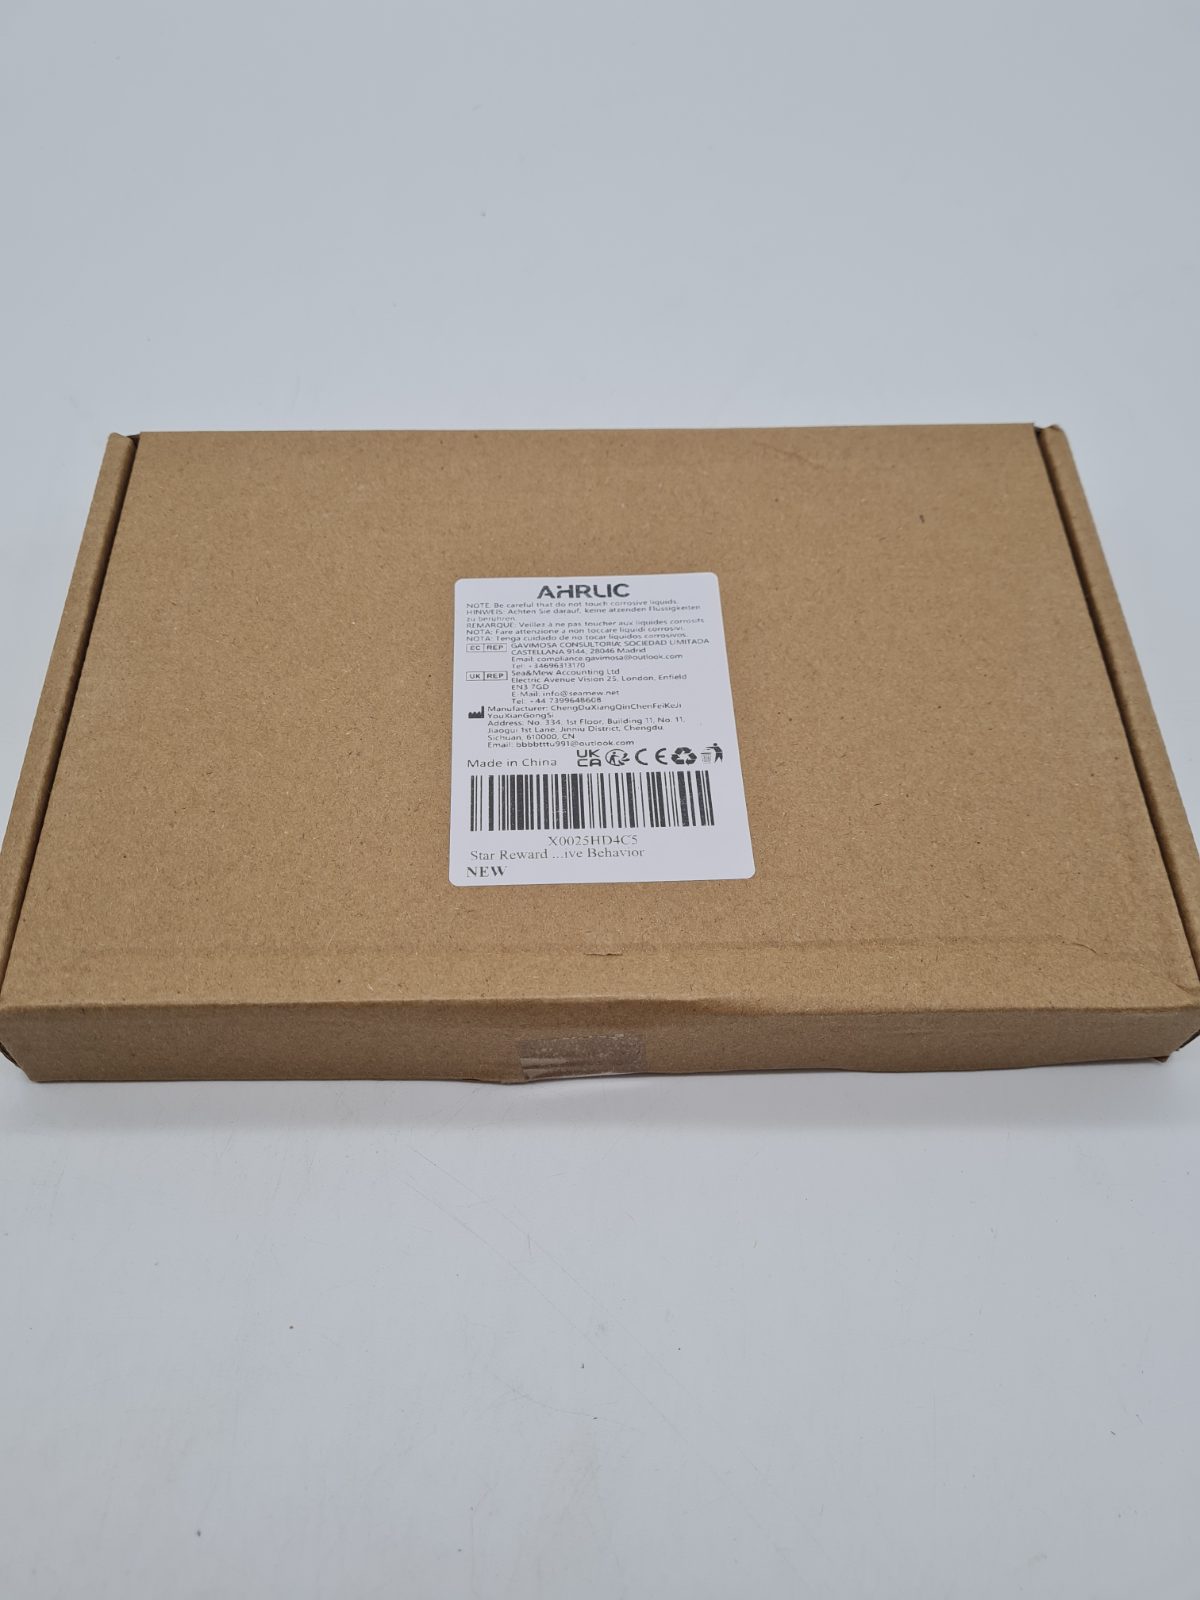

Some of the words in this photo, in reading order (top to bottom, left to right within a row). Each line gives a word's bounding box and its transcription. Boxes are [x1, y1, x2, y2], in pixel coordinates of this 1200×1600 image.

[537, 583, 630, 599] AHRLIC
[576, 749, 600, 758] UK
[522, 758, 557, 766] China
[548, 835, 638, 846] X0025HD4C5
[470, 851, 495, 860] Star
[500, 849, 548, 860] Reward
[587, 848, 645, 858] Behavior
[466, 866, 508, 877] NEW
